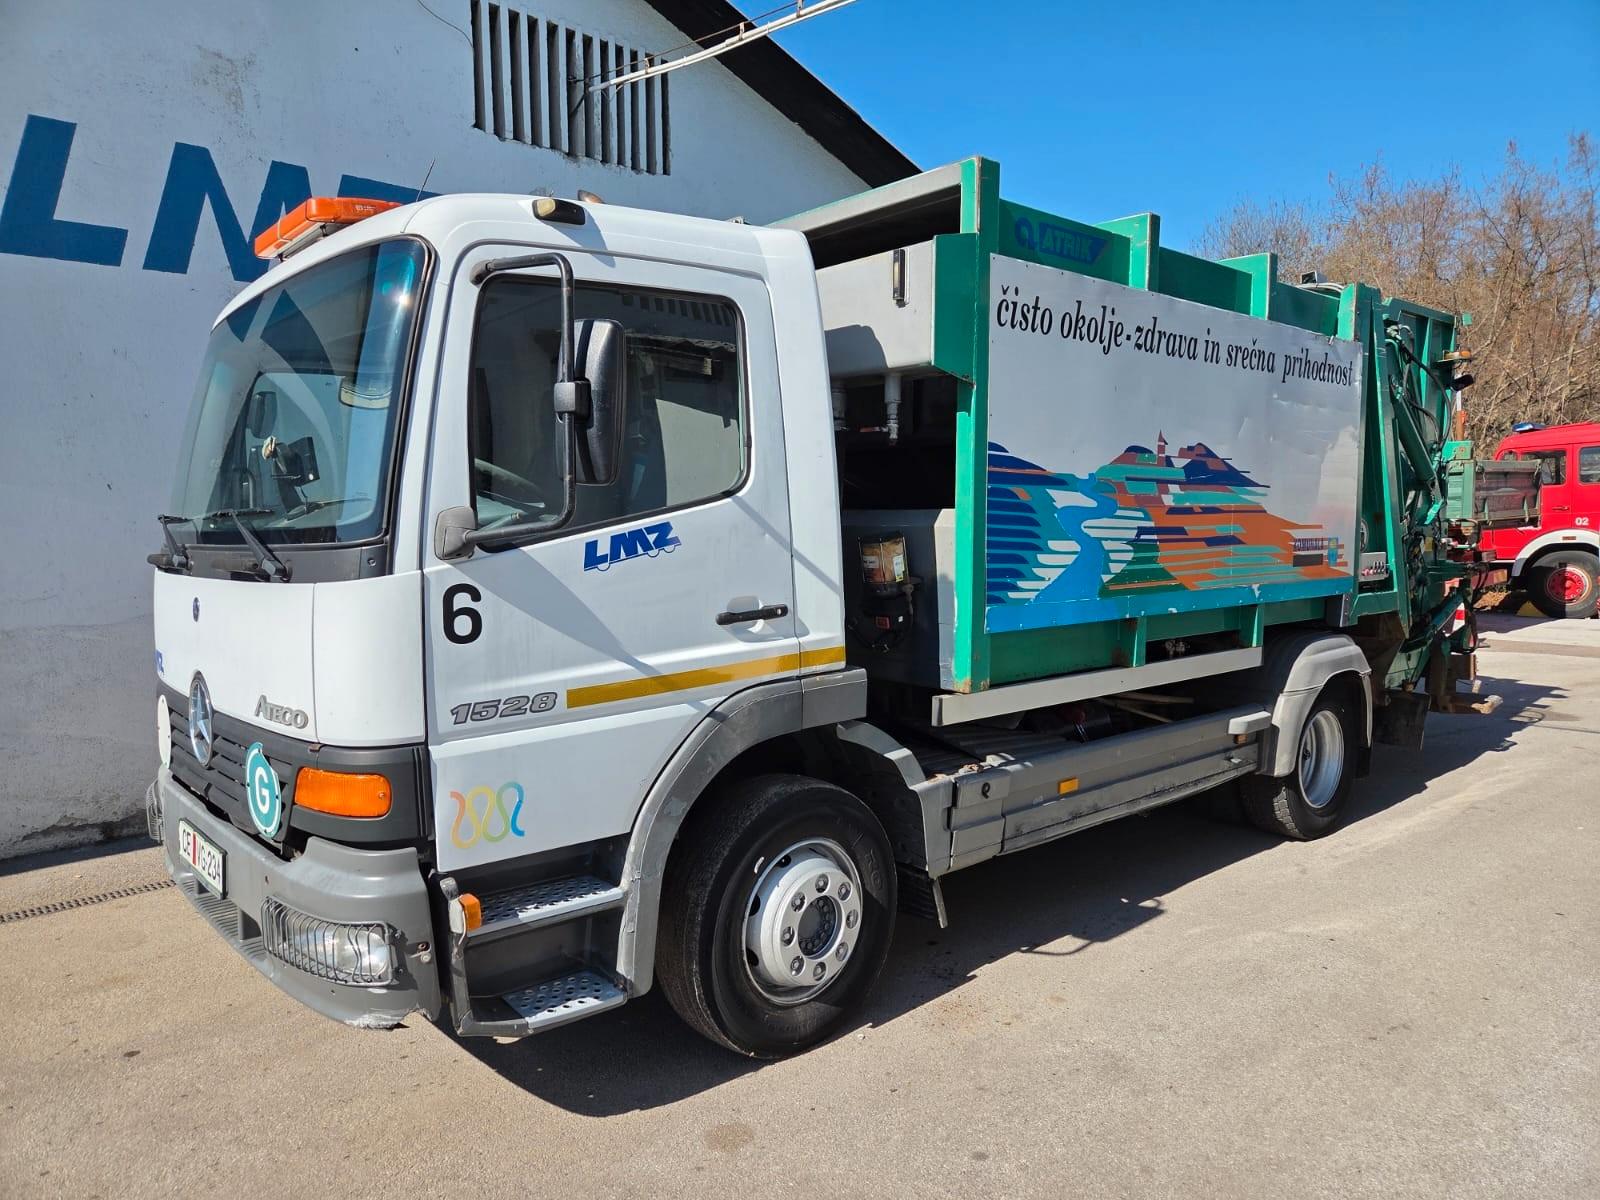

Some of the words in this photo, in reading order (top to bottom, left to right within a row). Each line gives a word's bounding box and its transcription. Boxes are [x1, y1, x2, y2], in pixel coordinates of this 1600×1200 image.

[0, 114, 444, 283] LM
[997, 285, 1053, 335] čisto
[1203, 327, 1221, 365] in
[1226, 337, 1276, 374] srečna
[1282, 347, 1354, 386] prihodnost
[584, 521, 681, 571] LMZ
[1575, 517, 1589, 526] 02
[442, 583, 482, 644] 6
[450, 692, 558, 725] 1528
[255, 766, 270, 814] G
